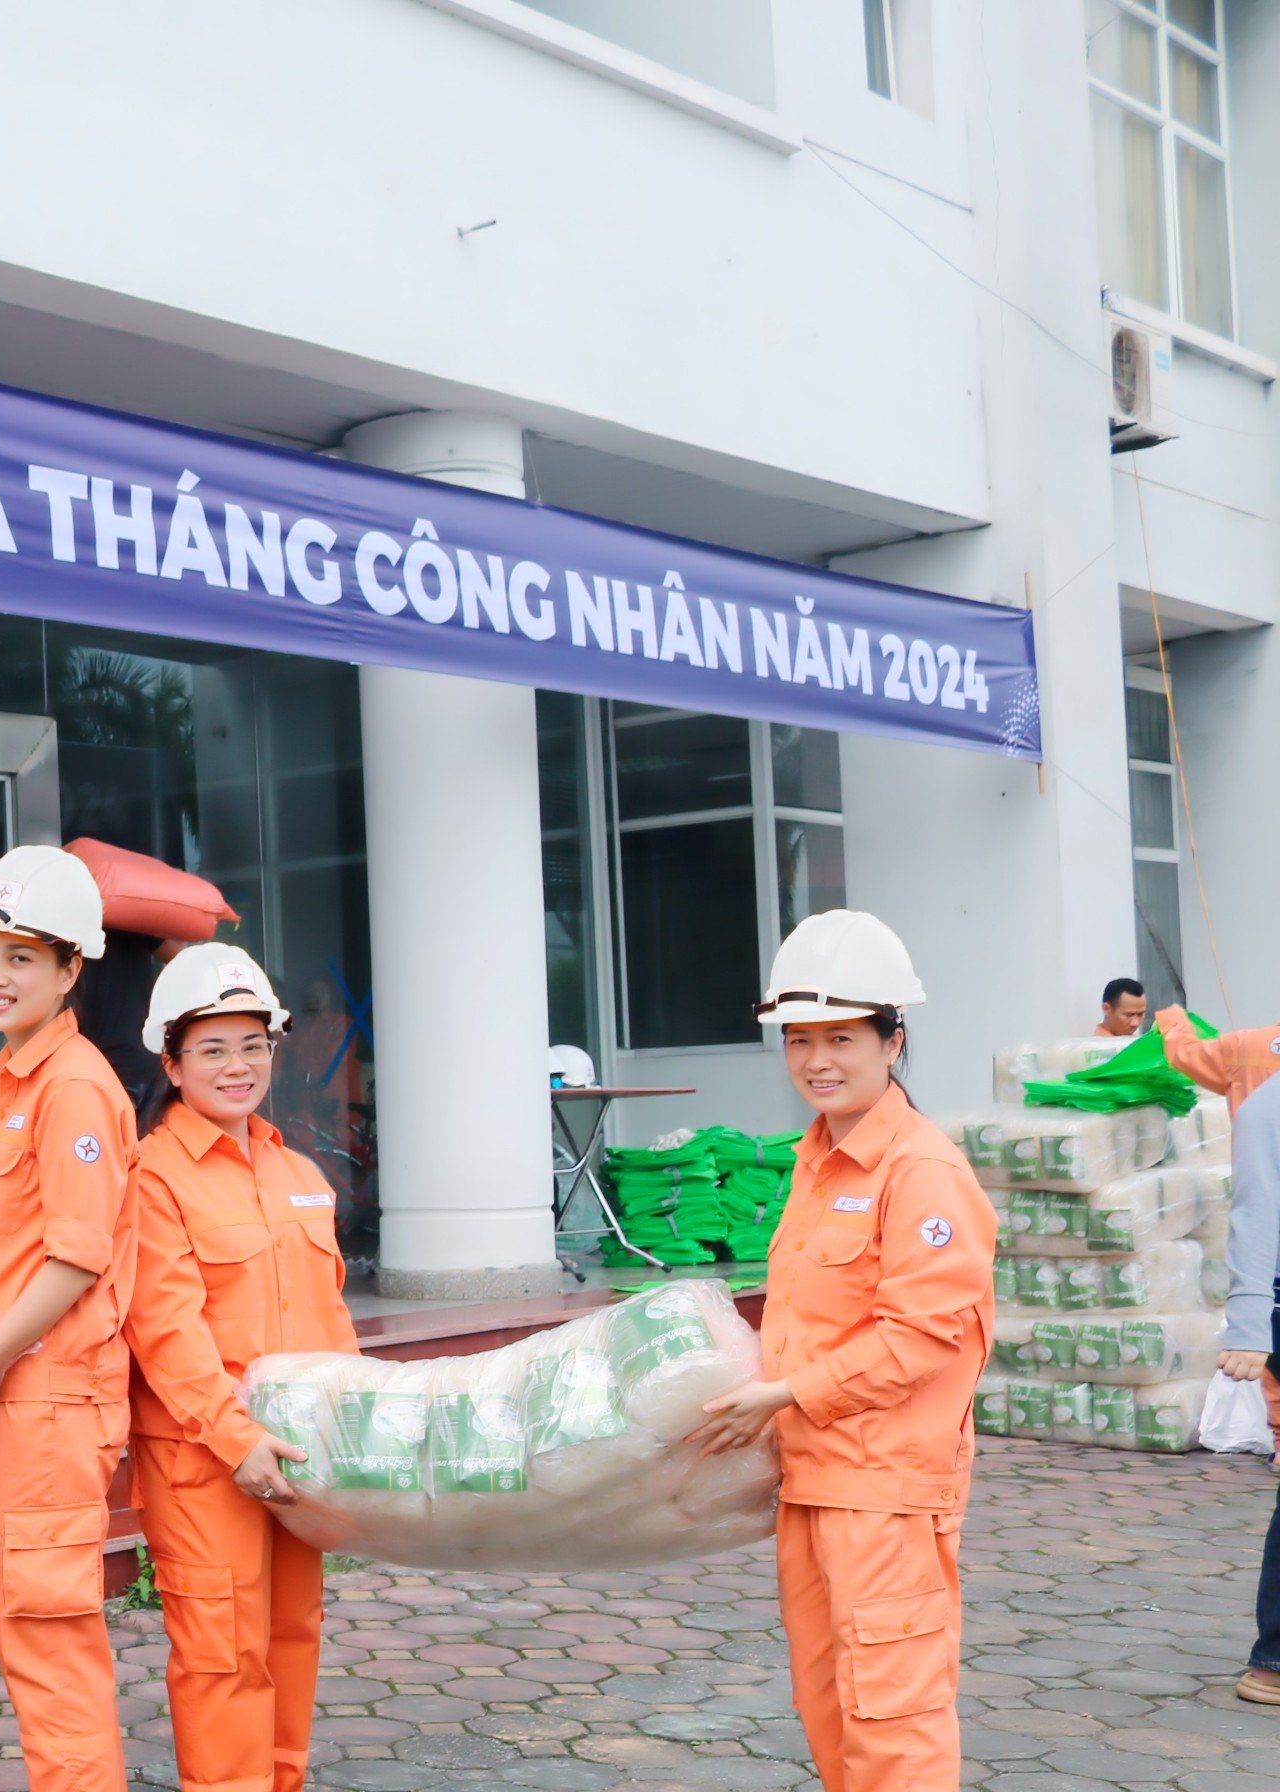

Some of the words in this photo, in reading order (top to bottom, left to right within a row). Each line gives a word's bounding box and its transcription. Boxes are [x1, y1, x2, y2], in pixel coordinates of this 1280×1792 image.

[28, 464, 343, 606] THÁNG
[354, 518, 556, 642] CÔNG
[565, 570, 743, 674] NHÂN
[750, 595, 873, 695] NĂM
[880, 634, 990, 713] 2024
